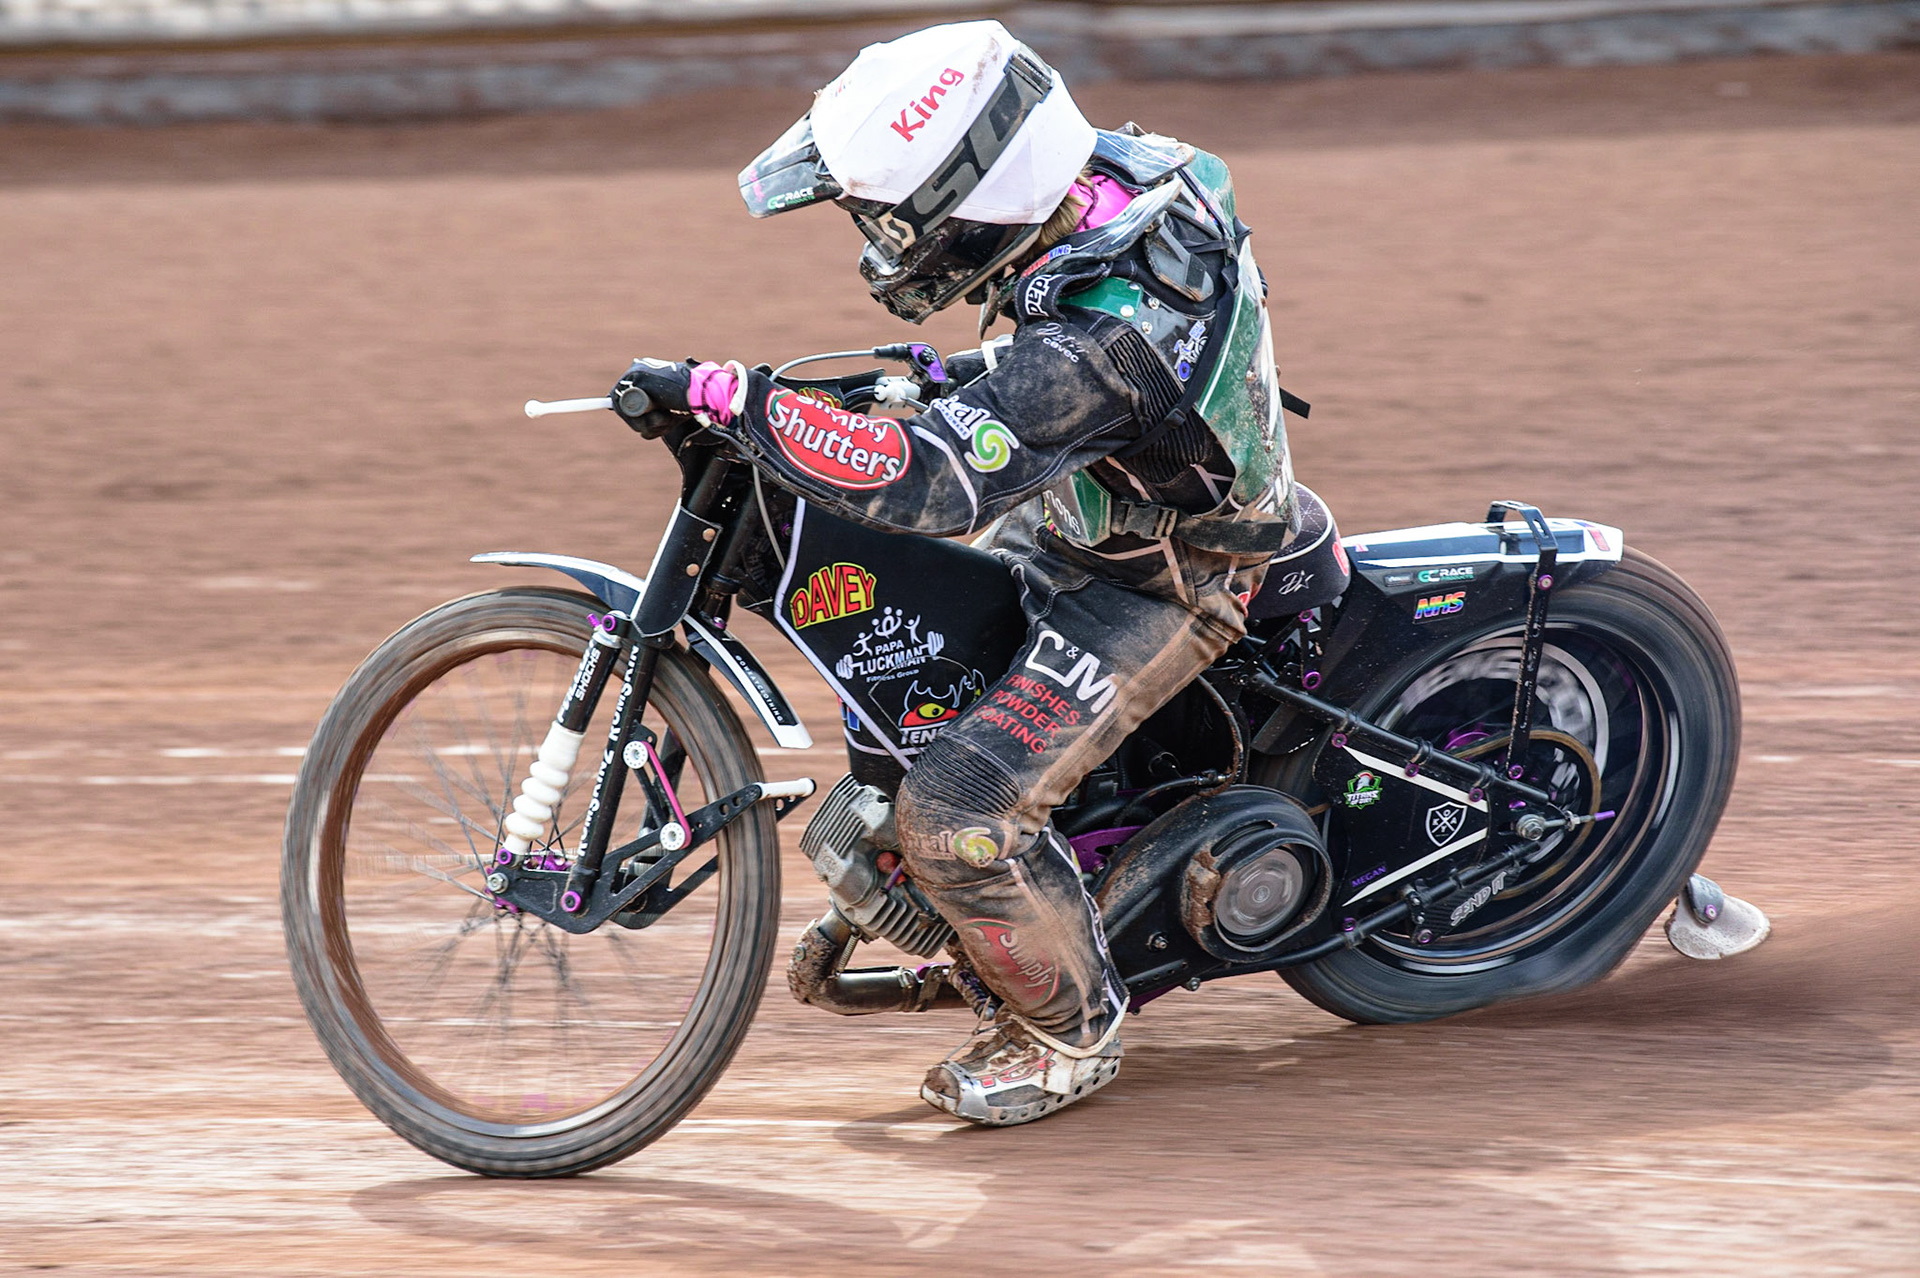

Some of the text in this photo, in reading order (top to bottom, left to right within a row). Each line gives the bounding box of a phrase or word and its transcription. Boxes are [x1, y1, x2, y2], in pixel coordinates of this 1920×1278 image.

[890, 67, 965, 143] King
[785, 186, 814, 201] RACE
[767, 401, 900, 482] Shutters
[790, 562, 876, 630] DAVEY
[1440, 566, 1474, 577] RACE
[1414, 591, 1467, 620] NHS
[860, 647, 927, 676] LUCKMAN
[875, 640, 905, 656] PAPA
[575, 647, 601, 701] SHOCKS
[990, 689, 1061, 739] POWDER
[1006, 674, 1081, 726] FINISHES
[974, 705, 1047, 754] COATING
[1352, 866, 1387, 888] MEGAN
[1451, 871, 1508, 926] SEND IT
